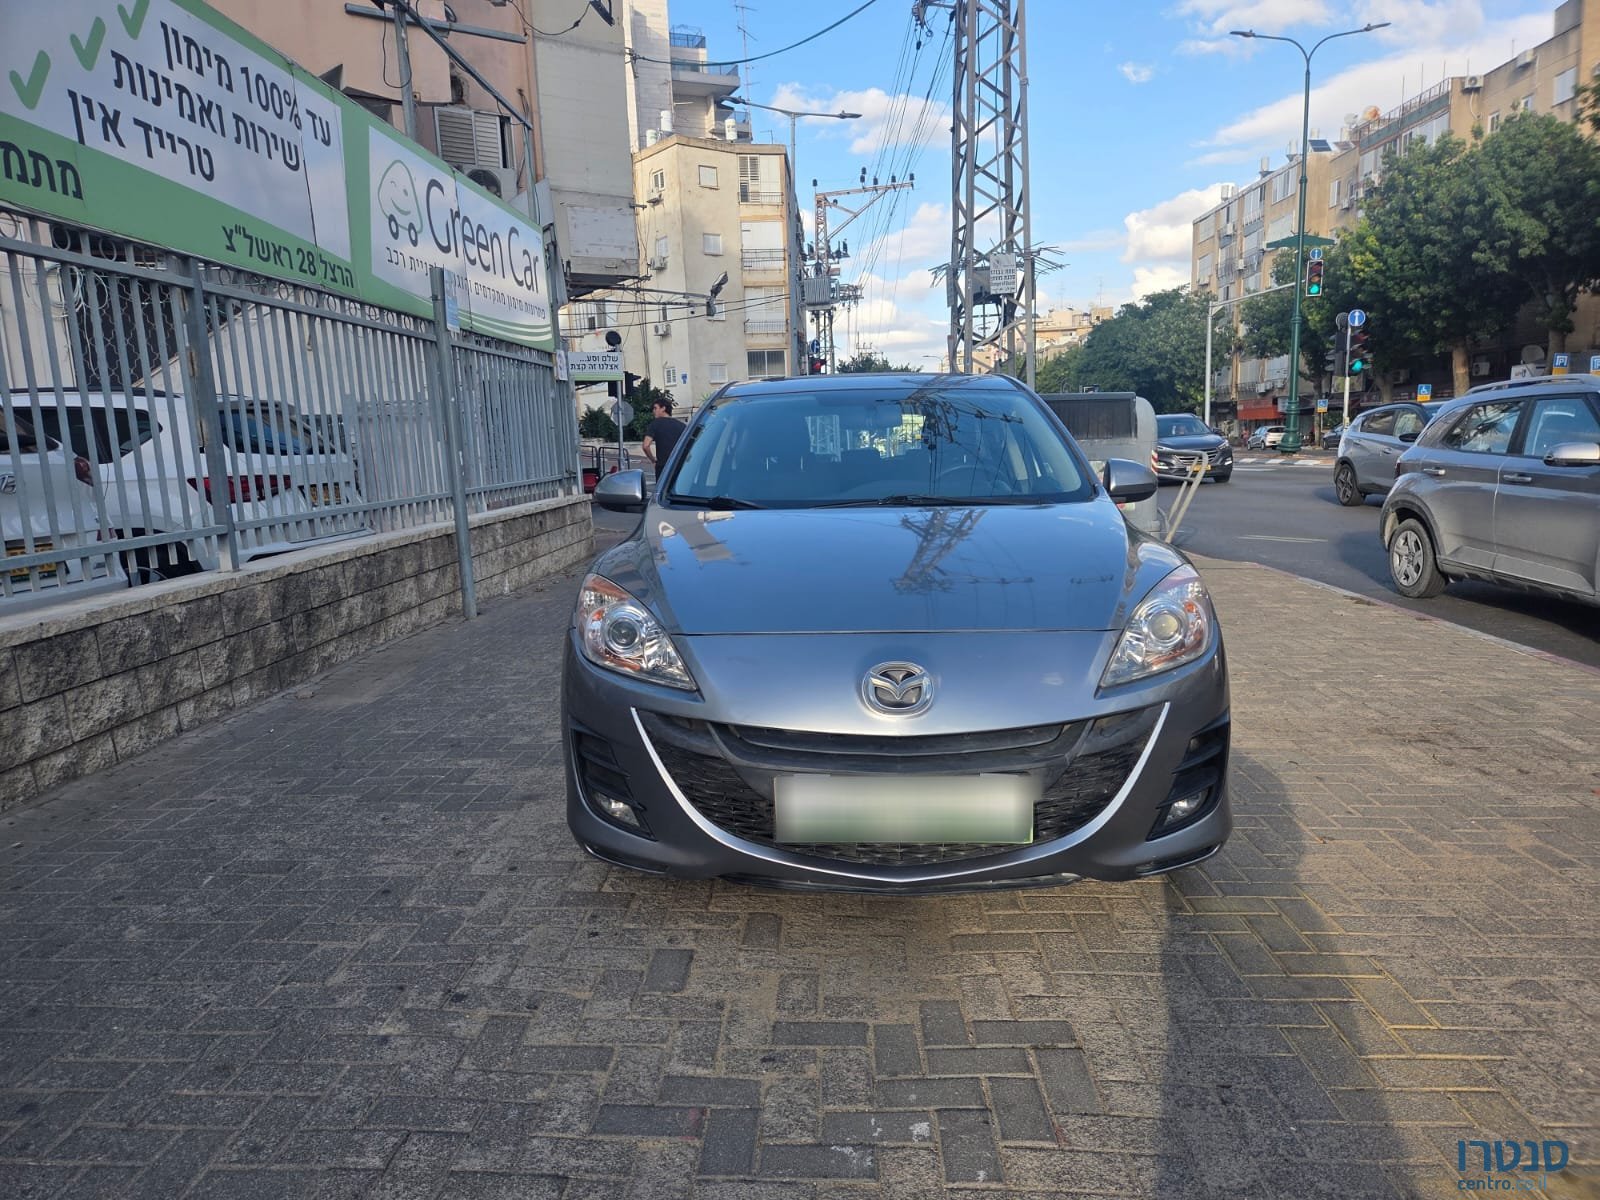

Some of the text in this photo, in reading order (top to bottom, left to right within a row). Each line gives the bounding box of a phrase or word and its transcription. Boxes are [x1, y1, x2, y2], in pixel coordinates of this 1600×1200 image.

[160, 20, 331, 147] עד 100% מימון
[110, 49, 301, 172] שירות ואמינות
[67, 89, 216, 182] טרייד אין
[426, 178, 540, 294] Green Car
[296, 247, 317, 276] 28
[318, 252, 354, 289] הרצל
[385, 246, 406, 268] רכב
[409, 256, 437, 277] ניית
[570, 363, 586, 372] קצת
[598, 362, 619, 370] אצלנו
[601, 354, 619, 362] שלם
